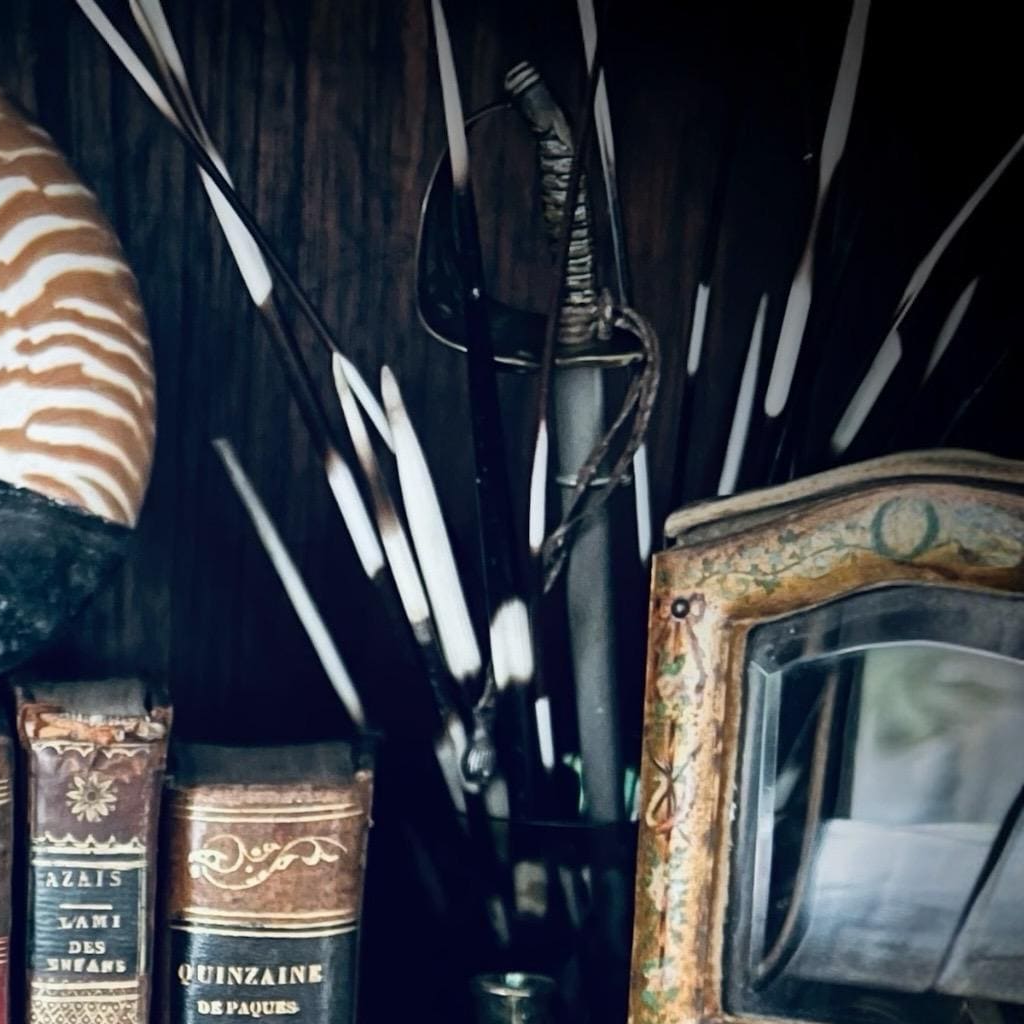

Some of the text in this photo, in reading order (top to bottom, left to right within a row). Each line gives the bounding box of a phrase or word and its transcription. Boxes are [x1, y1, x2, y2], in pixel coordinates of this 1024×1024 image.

[45, 870, 122, 888] AZAIS
[68, 941, 106, 955] DES
[177, 963, 324, 986] QUINZAINE
[197, 1000, 300, 1018] DE PAQUES
